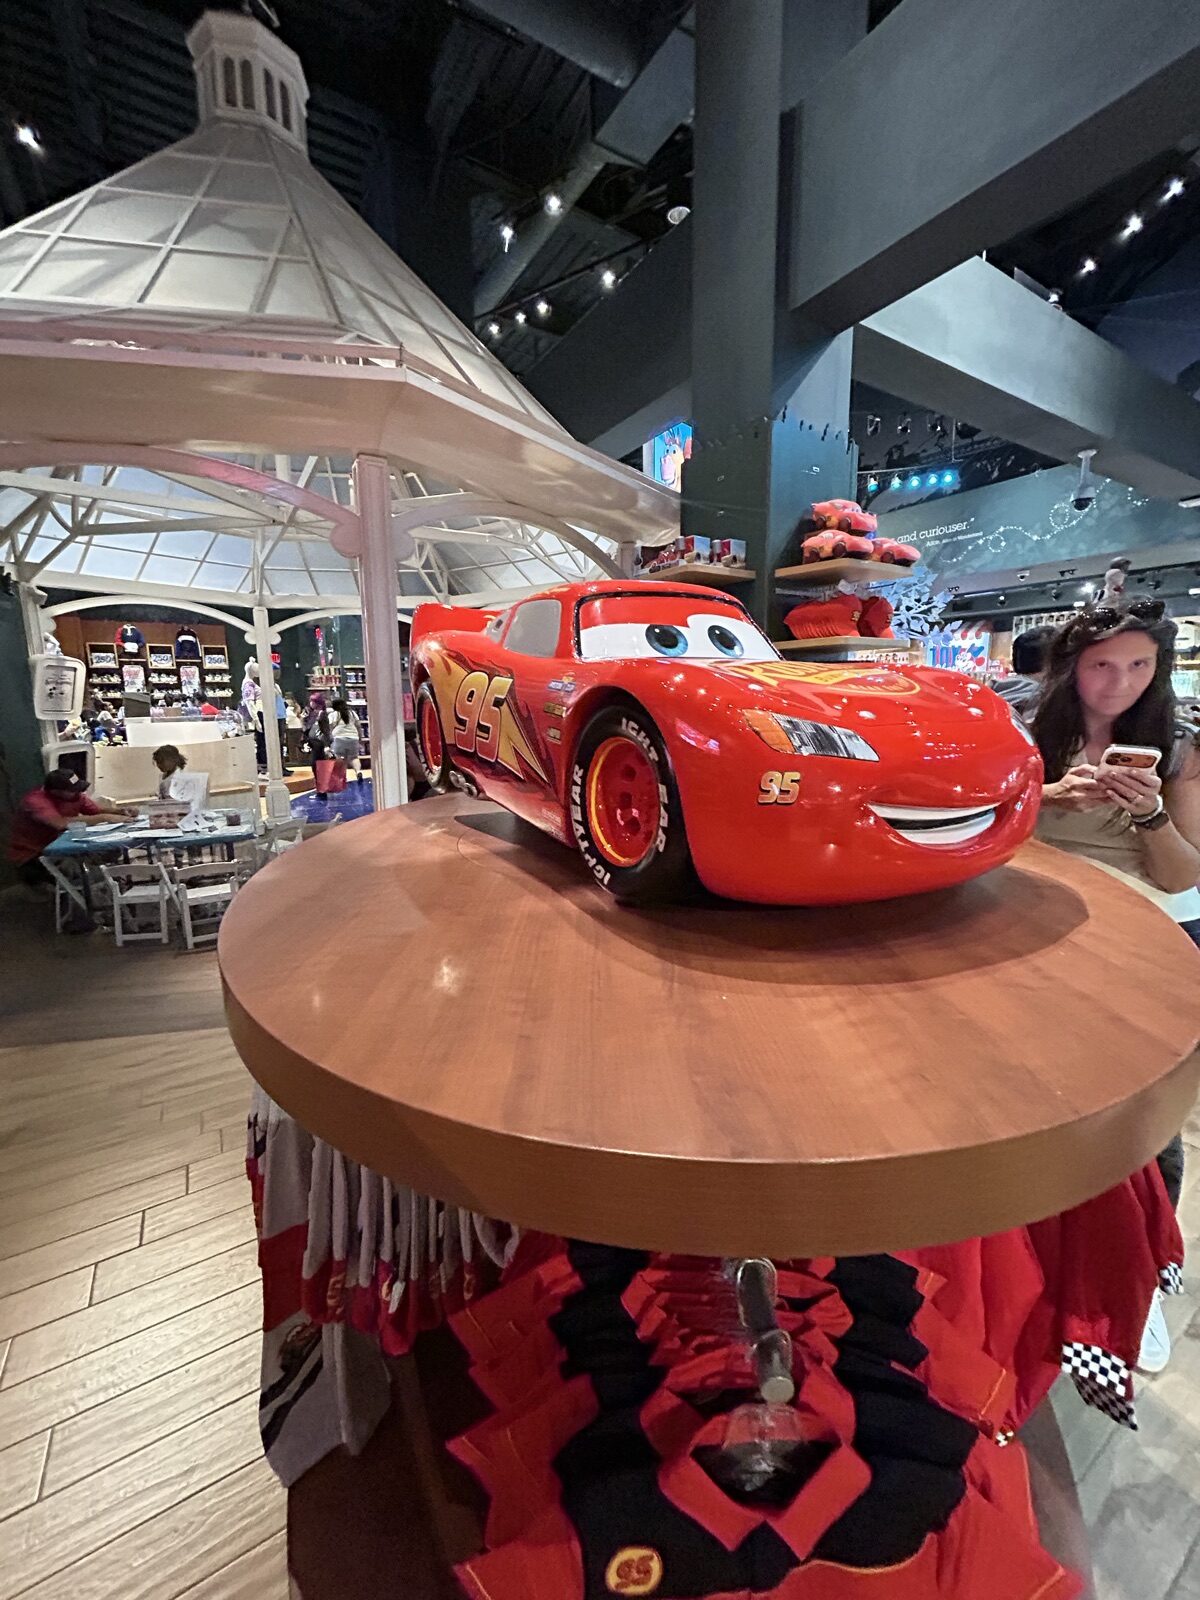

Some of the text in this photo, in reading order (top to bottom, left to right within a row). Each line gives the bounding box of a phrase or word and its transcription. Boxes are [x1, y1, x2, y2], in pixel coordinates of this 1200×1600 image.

[896, 531, 917, 544] and
[455, 671, 513, 763] 95
[758, 770, 801, 804] 95
